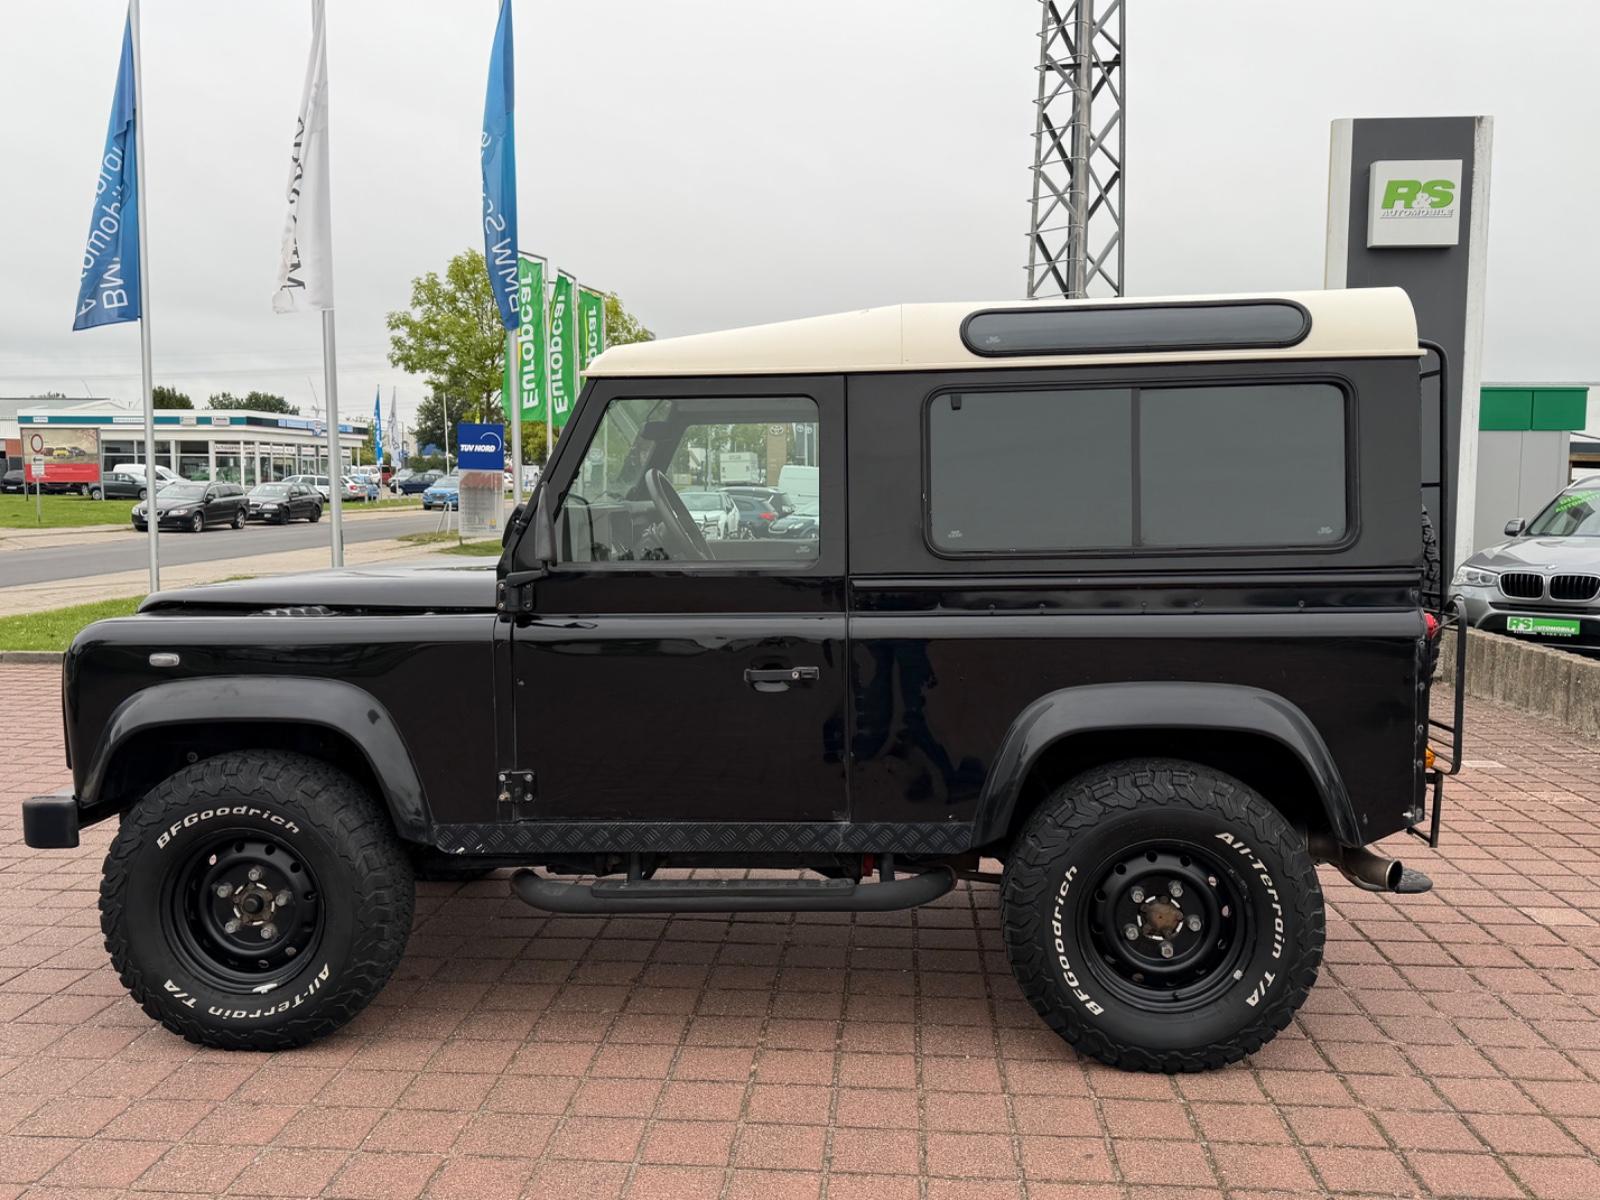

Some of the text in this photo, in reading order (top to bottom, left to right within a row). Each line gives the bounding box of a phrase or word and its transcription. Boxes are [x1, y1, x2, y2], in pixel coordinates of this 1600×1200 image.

[1381, 179, 1455, 209] R&S
[474, 444, 496, 452] NORD
[156, 805, 300, 849] BFGoodrich
[1052, 865, 1104, 1016] BFGoodrich
[1215, 832, 1284, 1007] All-Terrain T/A
[163, 963, 330, 1020] All-Terrain T/A
